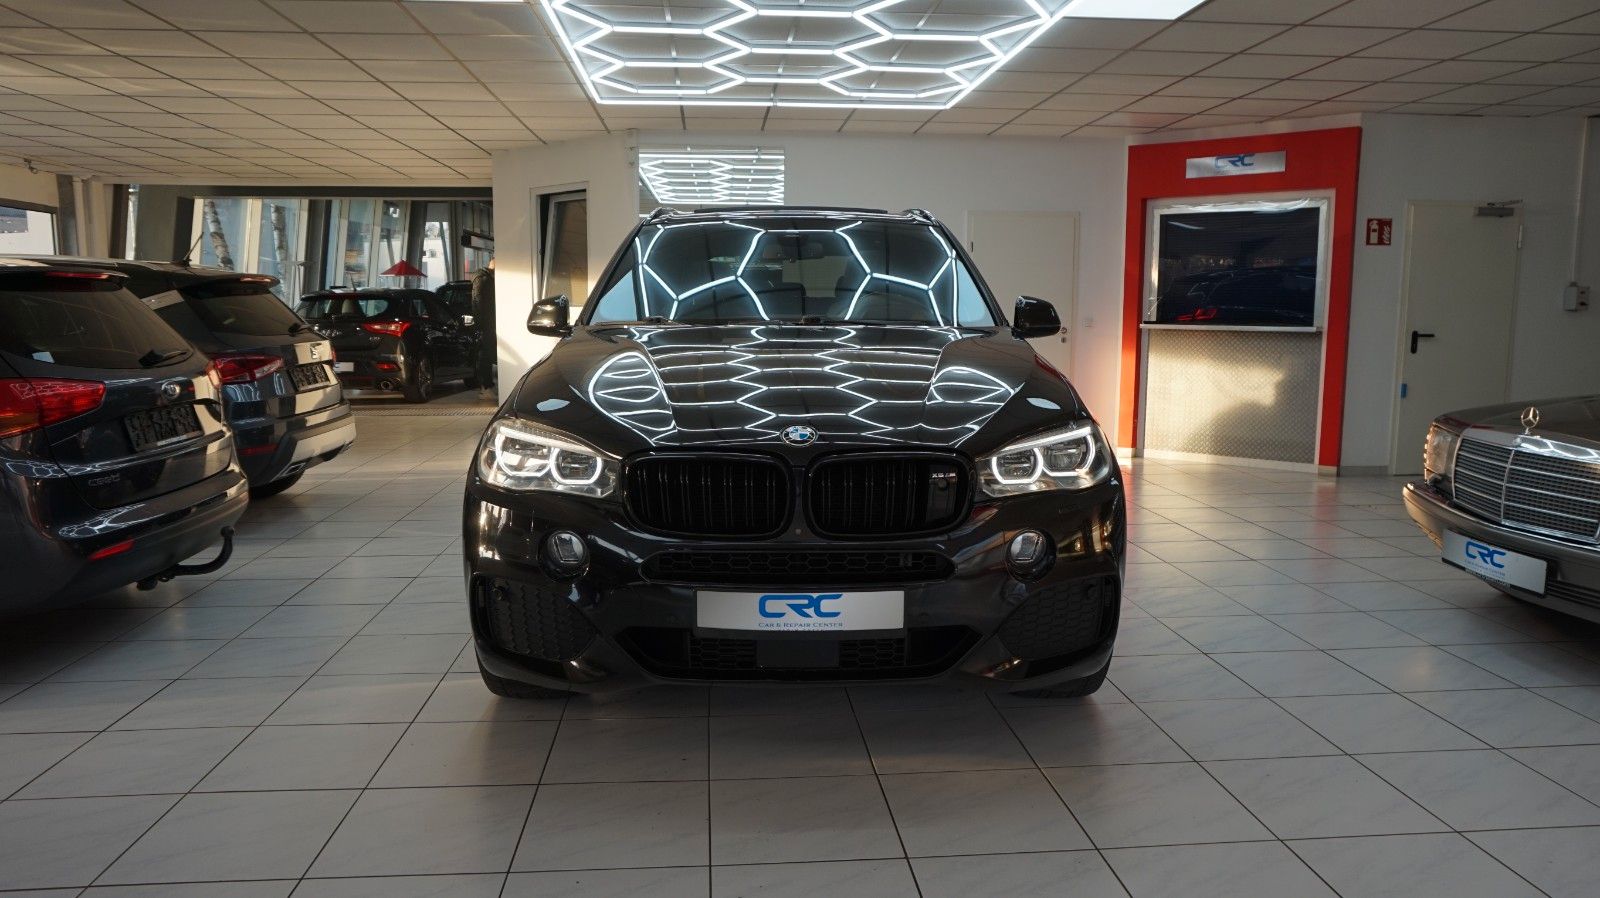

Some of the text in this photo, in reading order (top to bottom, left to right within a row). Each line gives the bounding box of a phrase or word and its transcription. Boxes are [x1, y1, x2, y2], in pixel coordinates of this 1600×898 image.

[1215, 153, 1255, 169] CRC
[1465, 541, 1506, 569] CRC
[758, 593, 844, 619] CRC
